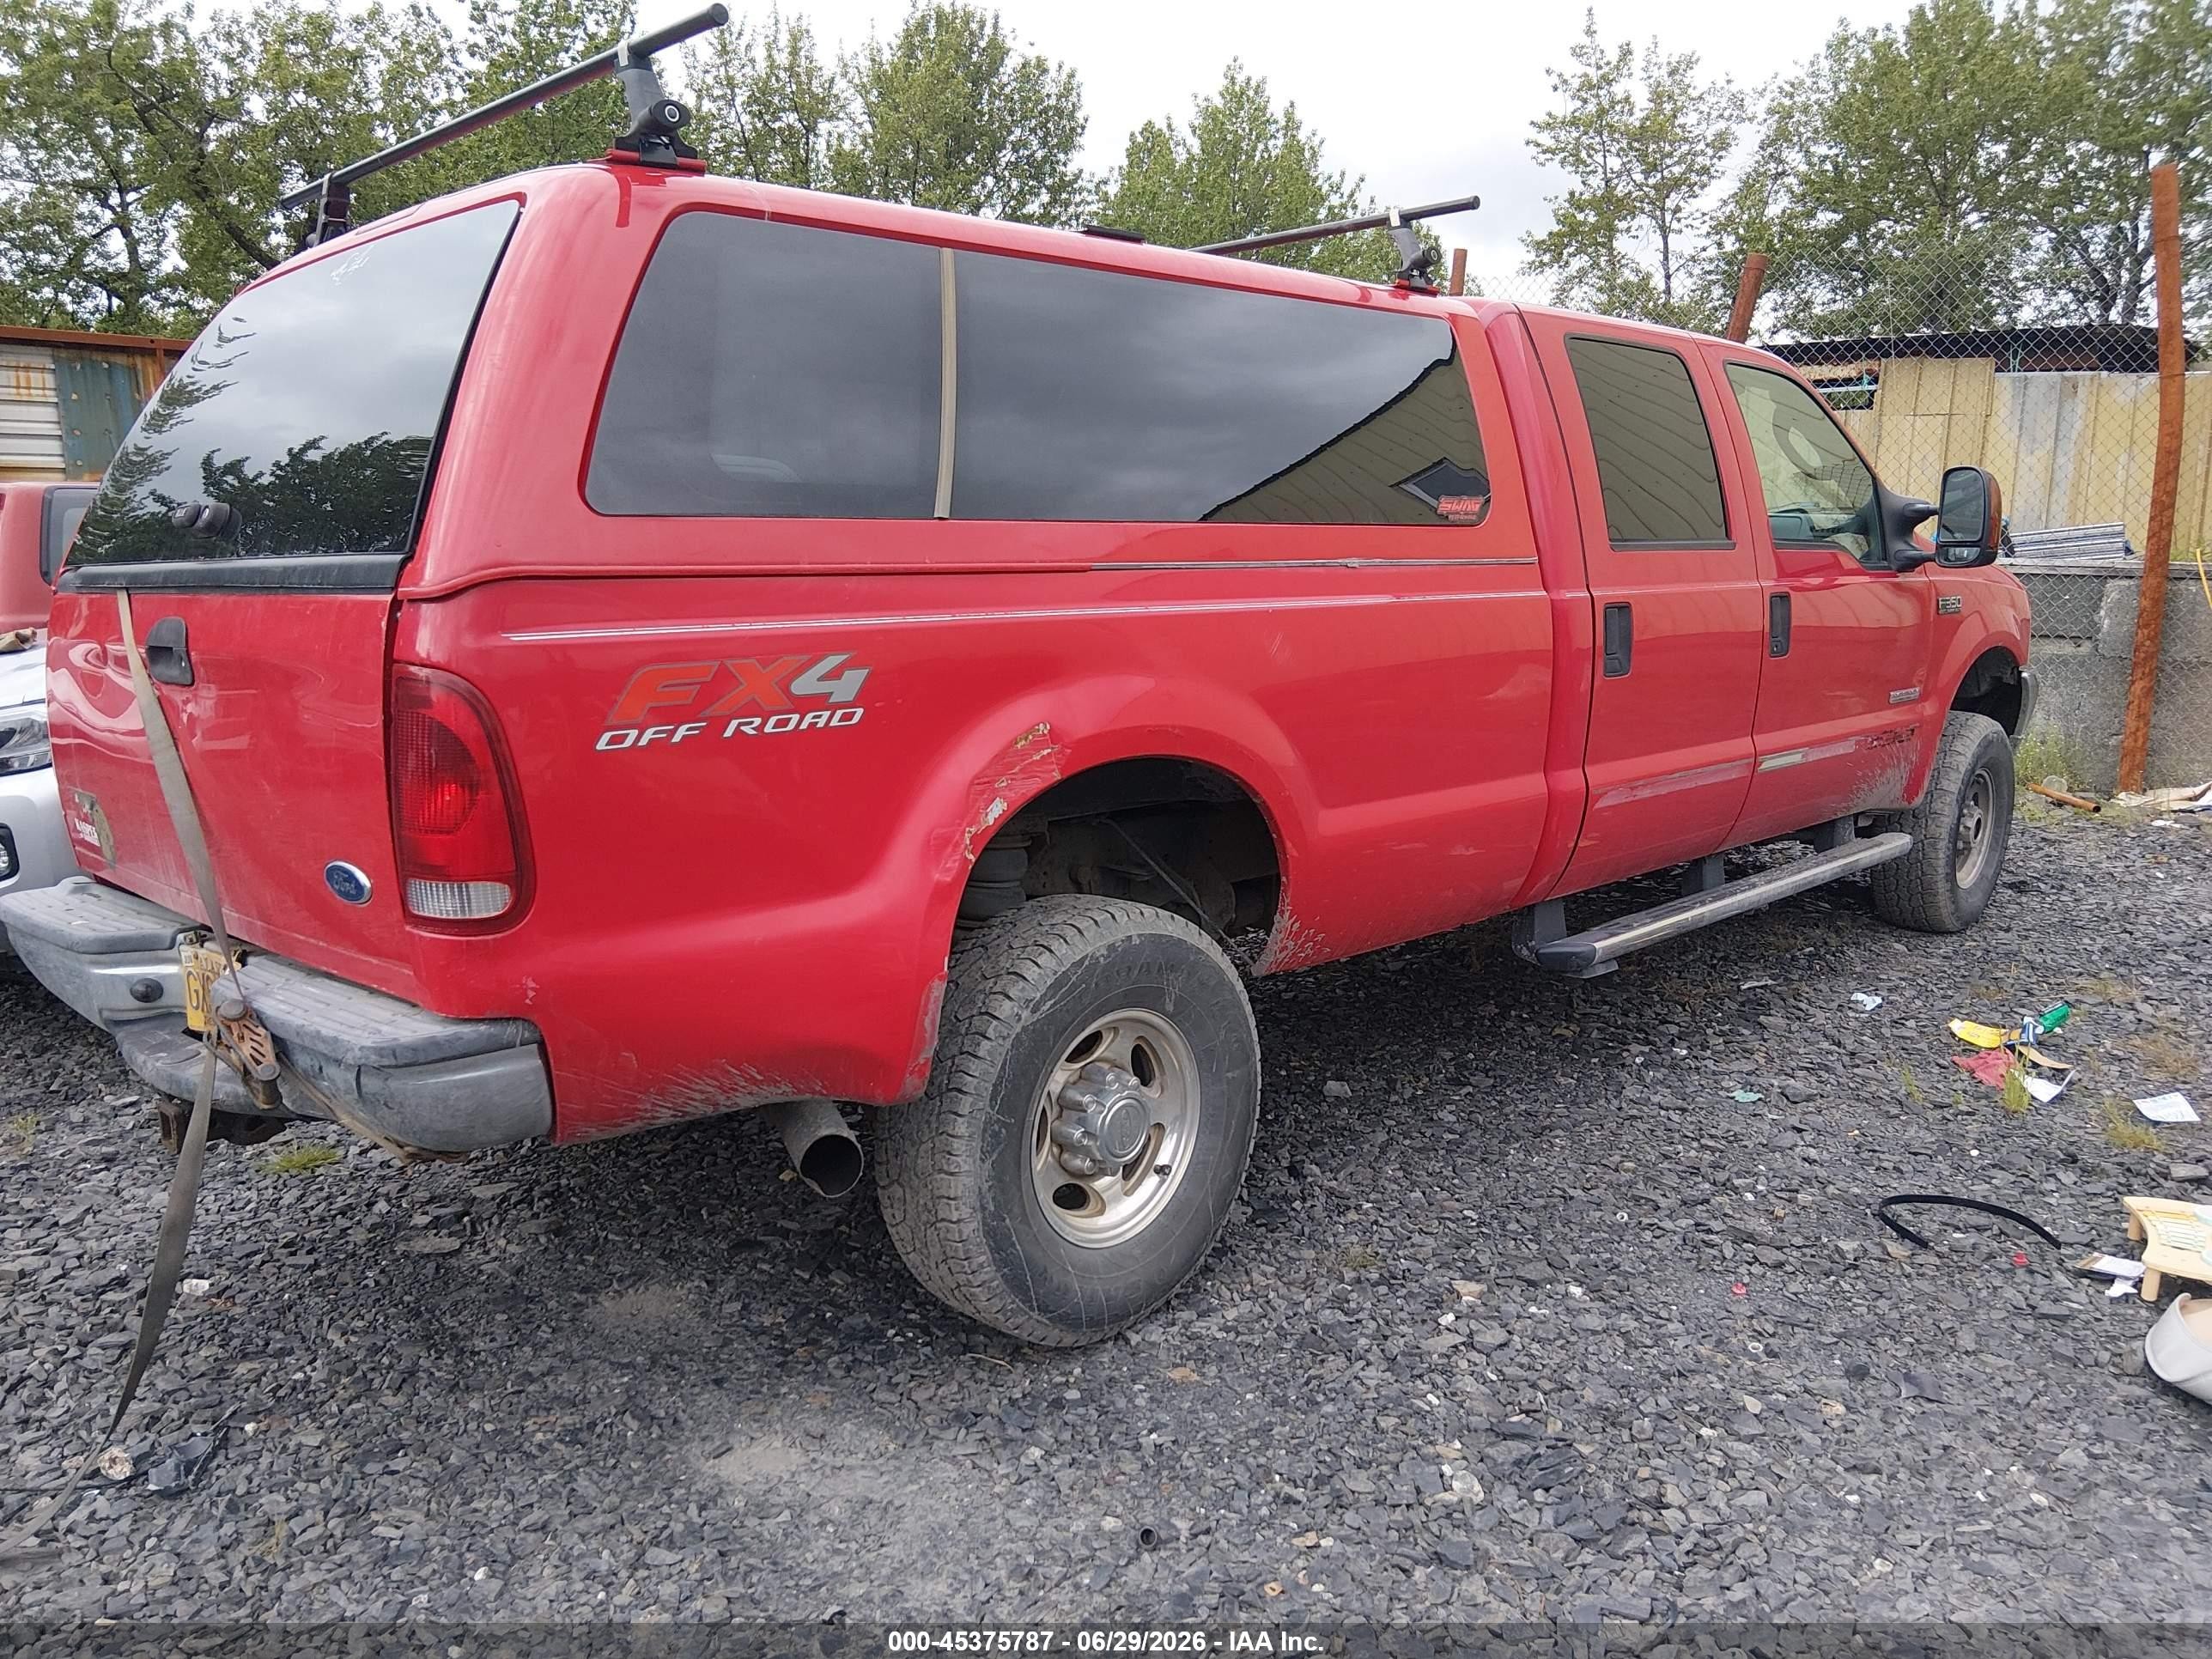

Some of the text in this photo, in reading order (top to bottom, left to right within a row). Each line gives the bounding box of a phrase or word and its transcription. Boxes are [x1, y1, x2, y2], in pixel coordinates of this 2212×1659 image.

[604, 652, 872, 726] FX4
[594, 707, 866, 750] OFF ROAD
